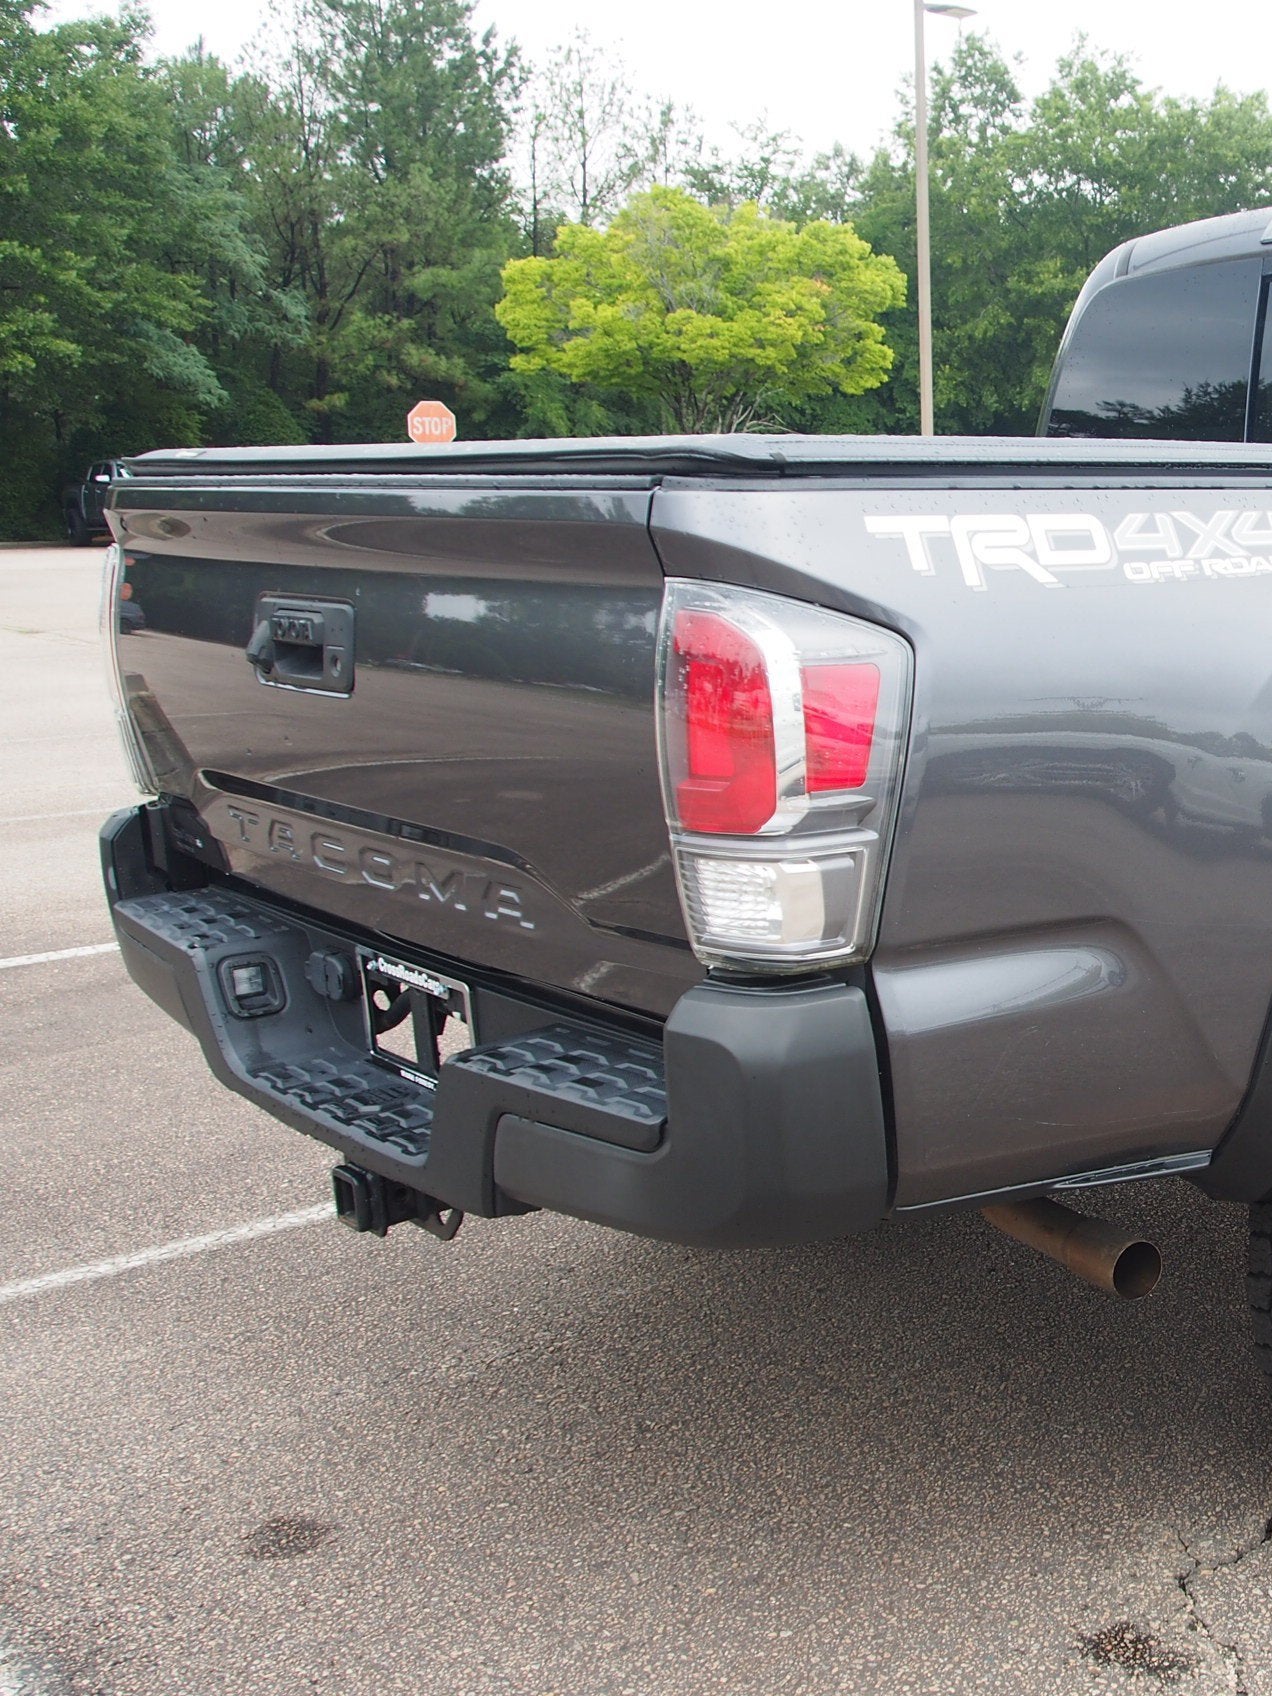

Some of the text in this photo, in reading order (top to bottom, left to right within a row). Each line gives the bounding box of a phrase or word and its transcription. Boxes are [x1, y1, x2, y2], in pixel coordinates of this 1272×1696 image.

[413, 416, 452, 435] STOP
[864, 513, 1117, 592] TRD
[1123, 559, 1199, 584] OFF
[226, 803, 536, 930] TACOMA
